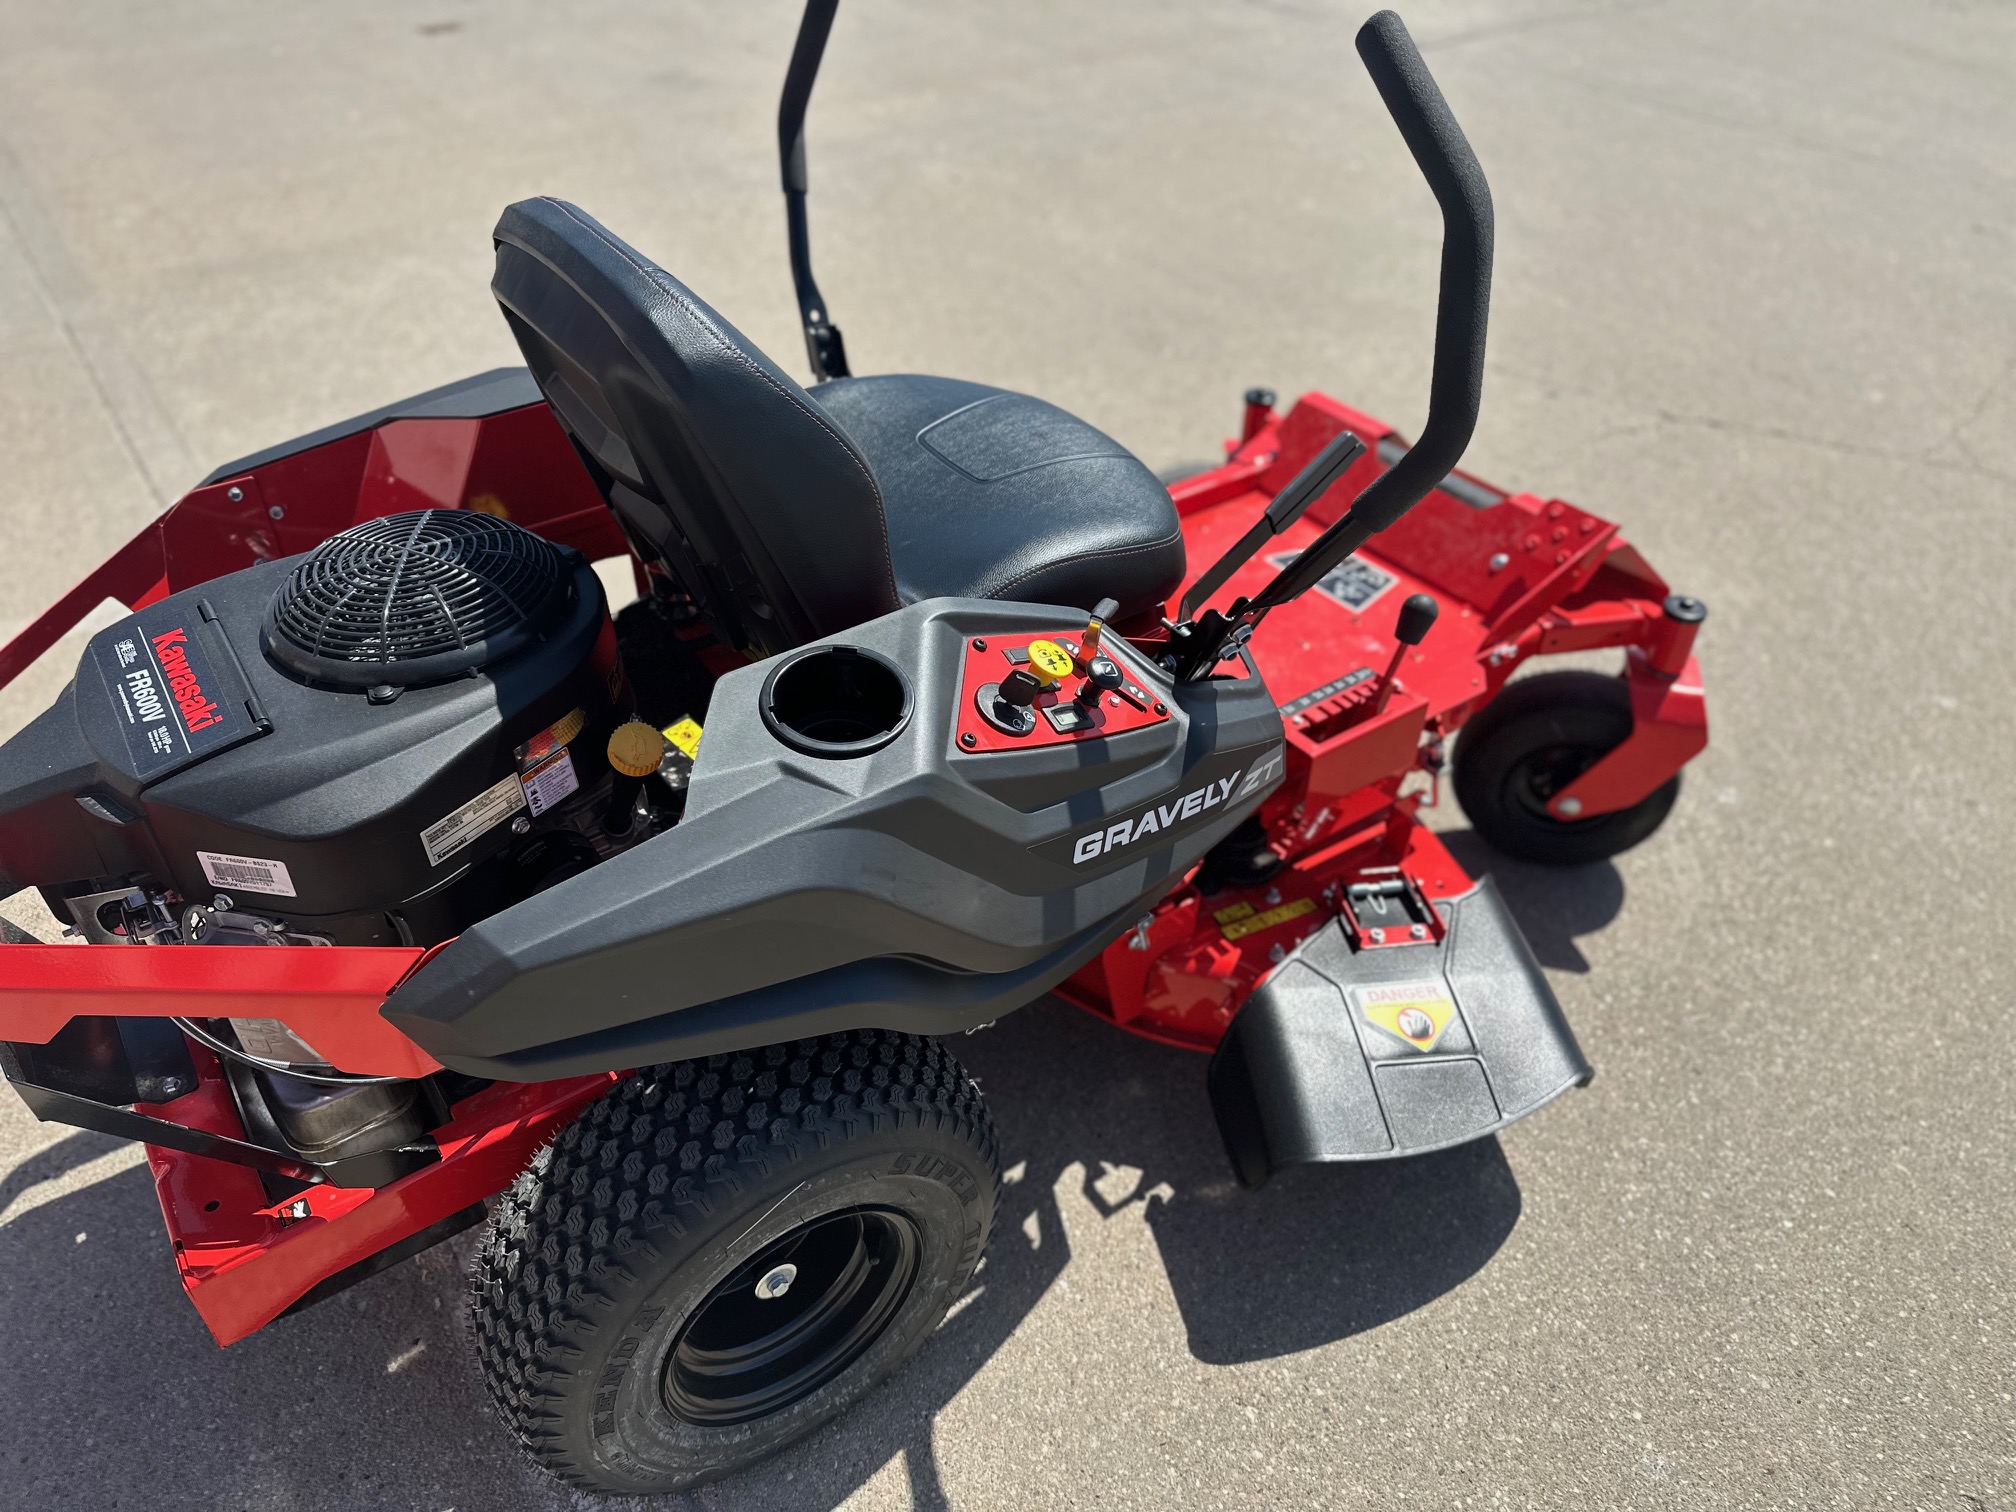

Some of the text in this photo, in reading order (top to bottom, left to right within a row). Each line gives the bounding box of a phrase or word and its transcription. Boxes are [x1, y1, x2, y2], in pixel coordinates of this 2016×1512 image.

[125, 669, 166, 722] FR600V
[151, 627, 223, 733] Kawasaki
[1073, 755, 1283, 865] GRAVELY ZT
[437, 837, 467, 861] Kawasaki
[1367, 986, 1440, 1002] DANGER
[888, 1153, 979, 1207] SUPER
[592, 1305, 666, 1439] KENDA
